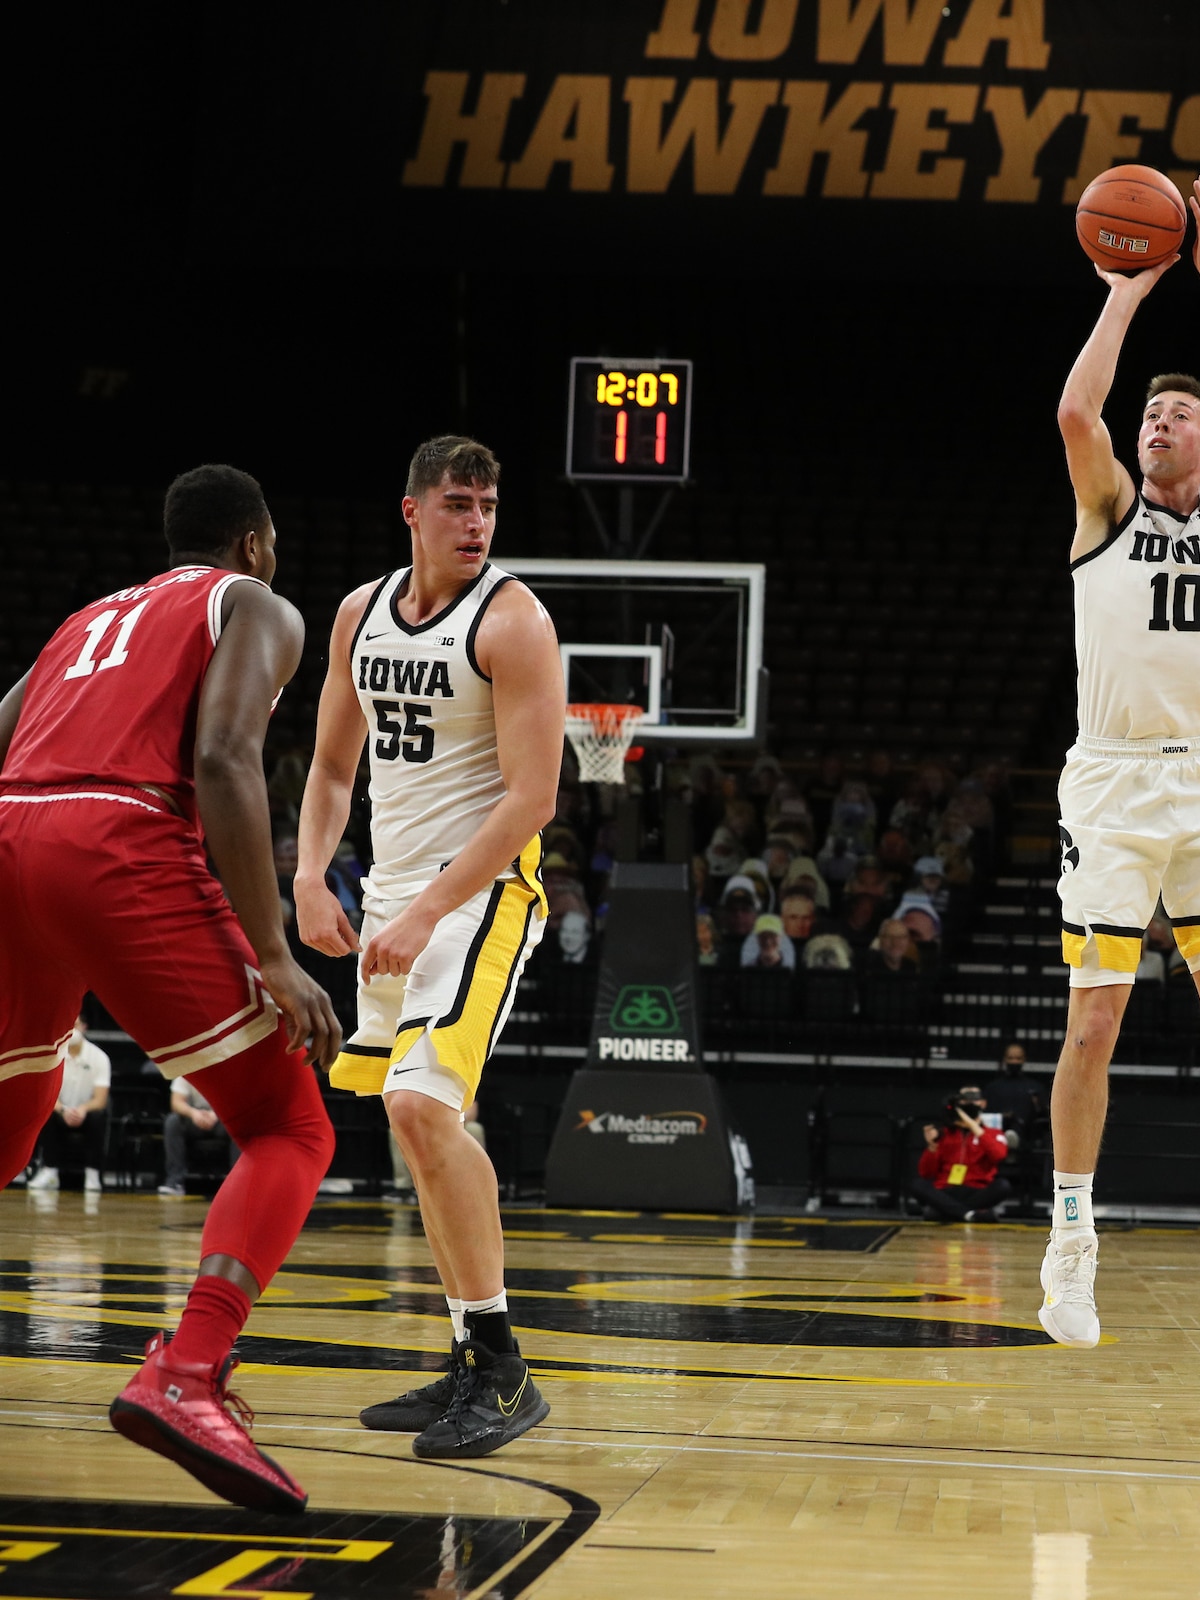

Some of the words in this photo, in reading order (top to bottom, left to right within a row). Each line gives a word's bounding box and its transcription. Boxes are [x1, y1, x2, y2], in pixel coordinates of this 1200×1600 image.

[596, 370, 680, 408] 12:07
[63, 598, 150, 681] 11
[358, 656, 455, 698] IOWA
[372, 699, 435, 763] 55
[1162, 745, 1189, 754] HAWKS
[606, 1114, 697, 1134] Mediacom
